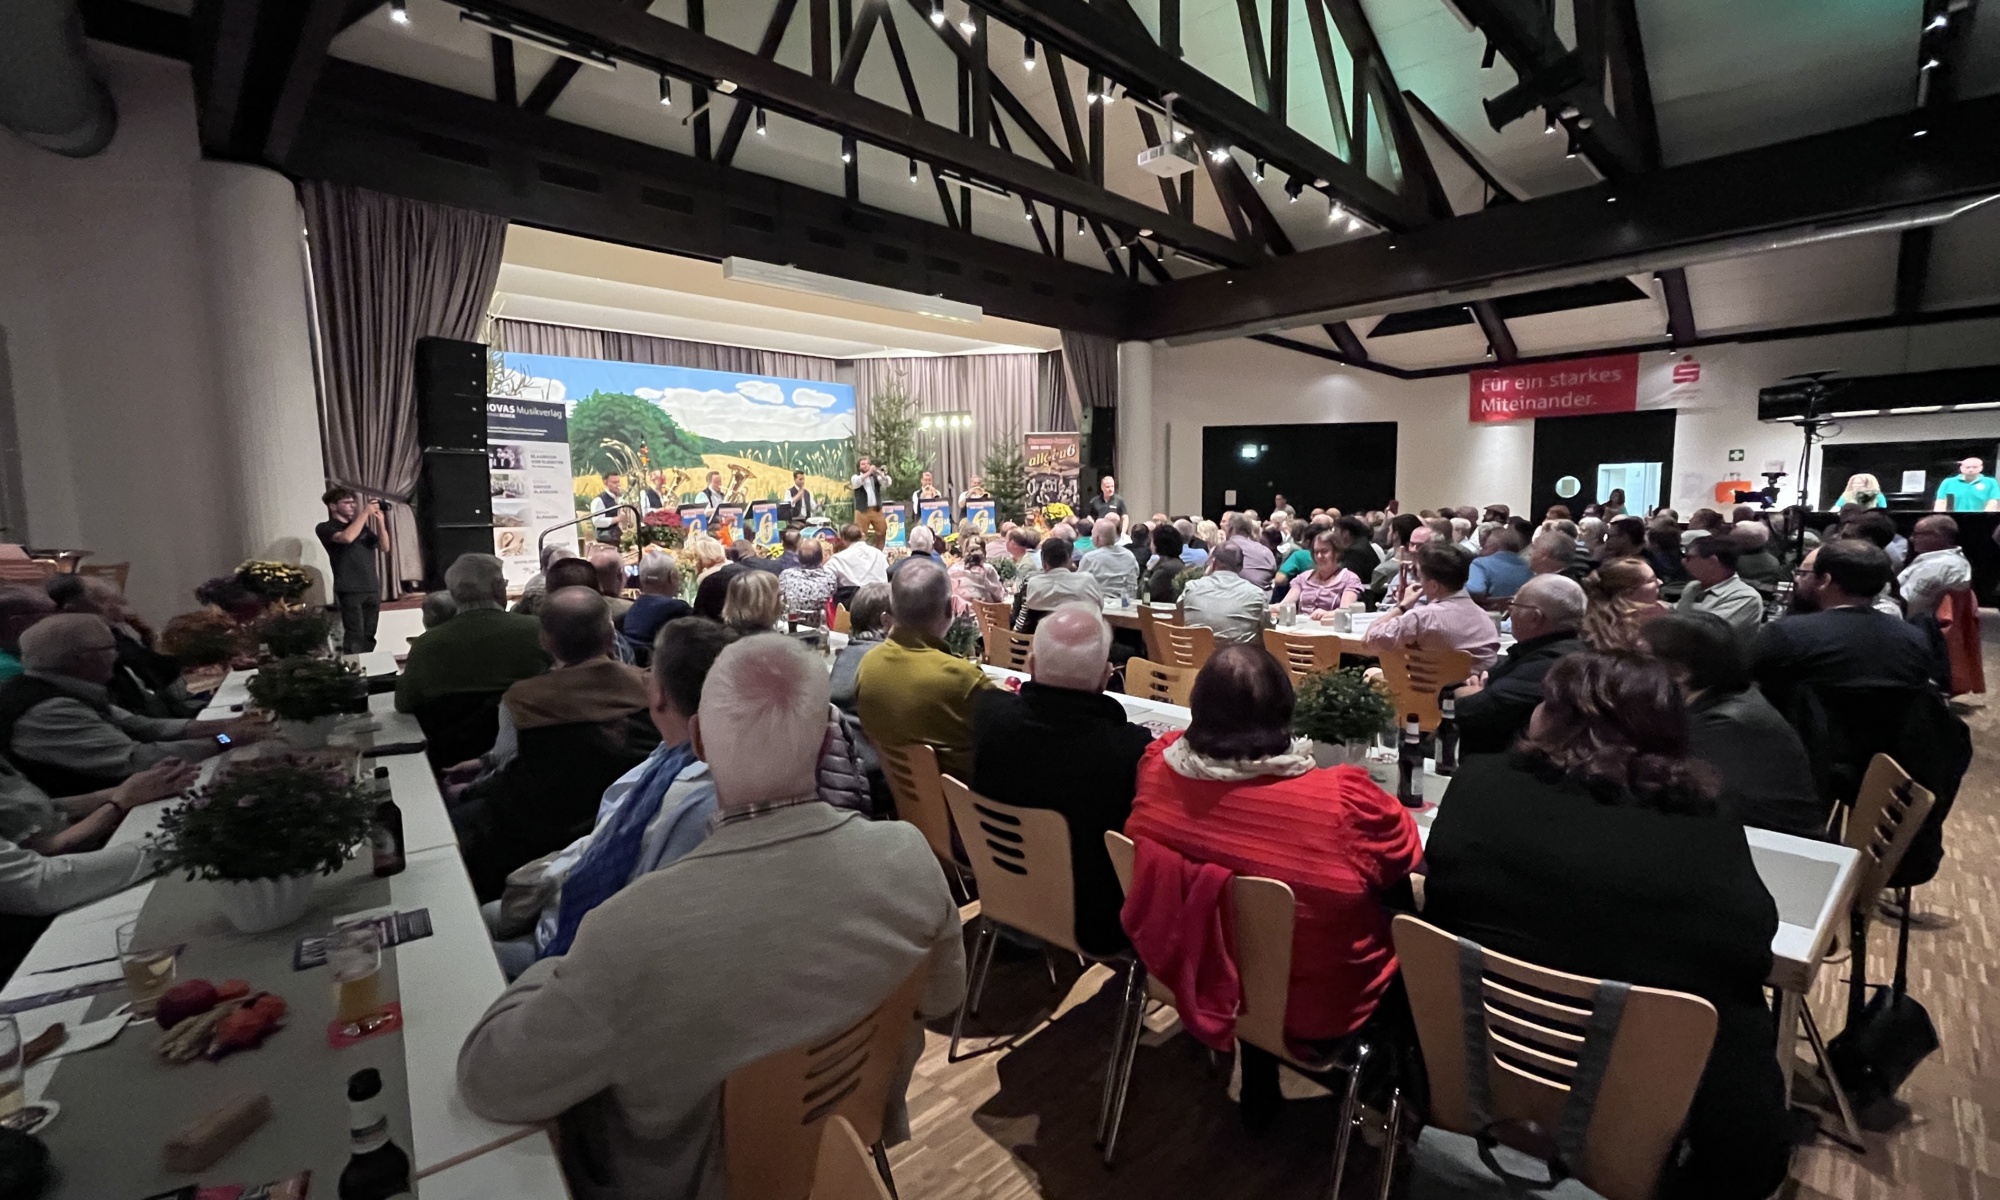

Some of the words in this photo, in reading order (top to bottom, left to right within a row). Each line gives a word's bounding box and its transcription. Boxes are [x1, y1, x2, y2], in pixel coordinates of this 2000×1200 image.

[1481, 377, 1510, 393] Für
[1515, 374, 1543, 390] ein
[1550, 368, 1622, 388] starkes
[1481, 391, 1598, 412] Miteinander.
[516, 405, 563, 420] Musikverlag
